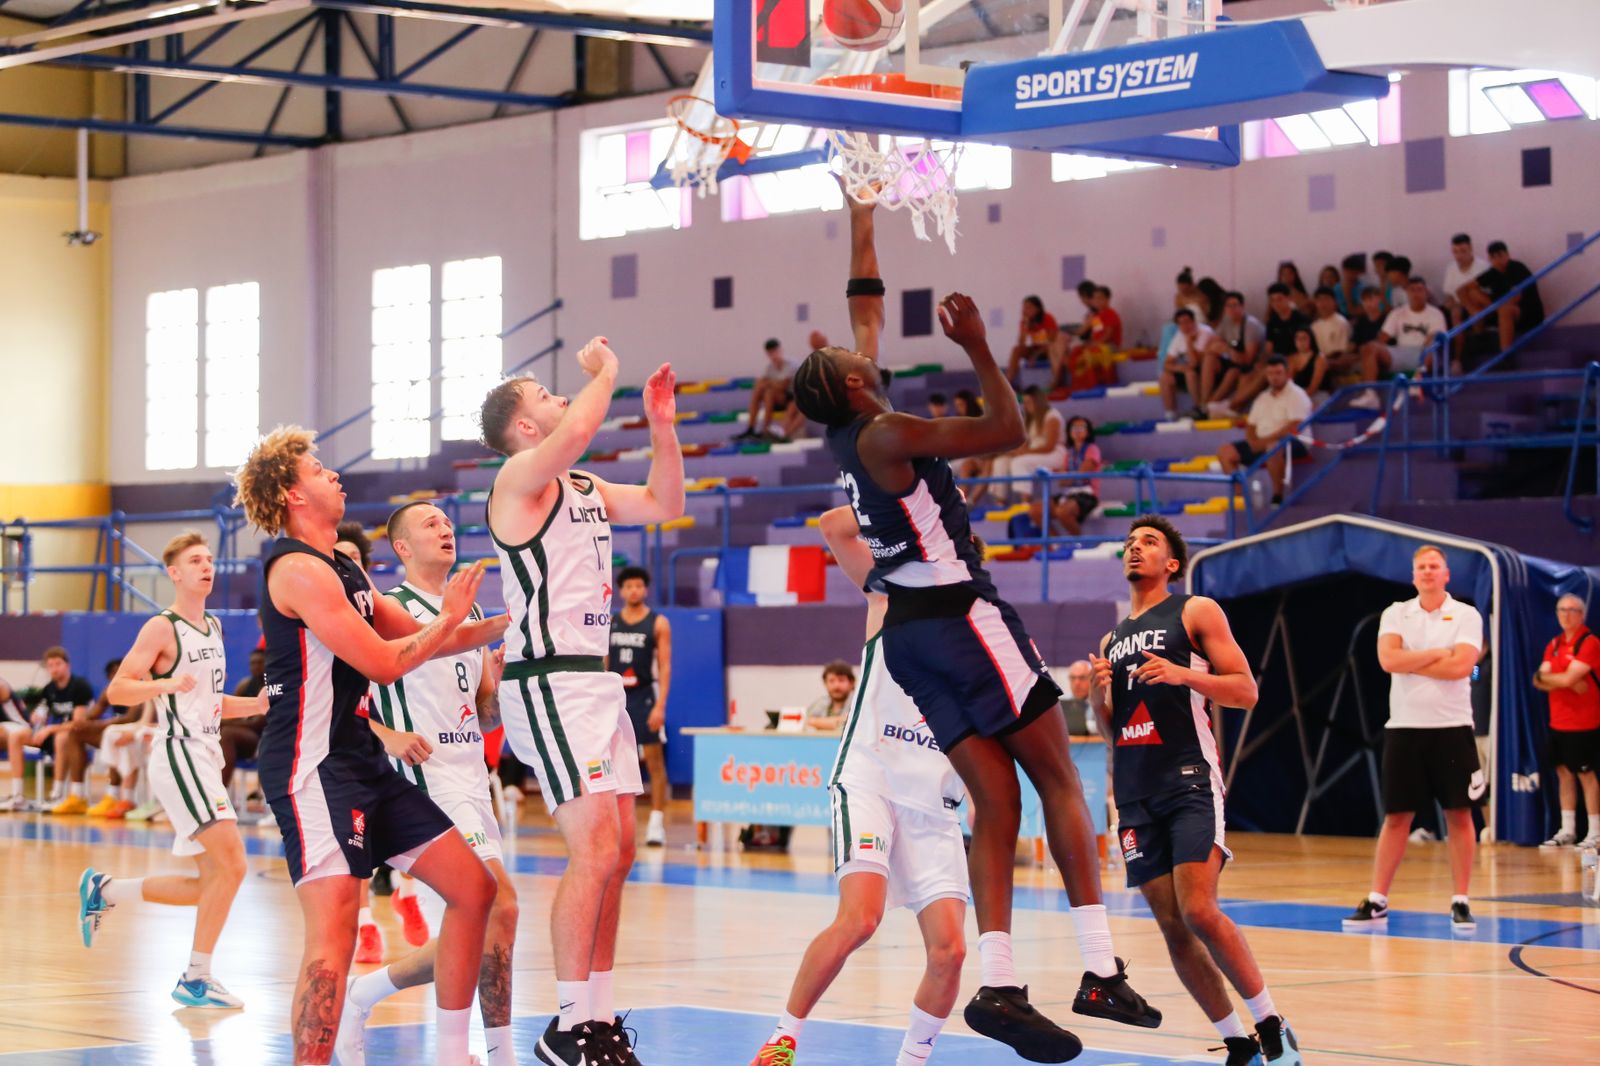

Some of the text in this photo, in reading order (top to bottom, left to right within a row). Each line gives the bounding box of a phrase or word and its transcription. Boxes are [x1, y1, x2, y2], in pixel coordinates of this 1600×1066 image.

[1108, 629, 1167, 663] FRANCE
[211, 668, 224, 694] 12
[455, 662, 469, 693] 8
[1126, 663, 1138, 691] 7
[1121, 721, 1155, 741] MAIF
[721, 754, 822, 793] deportes
